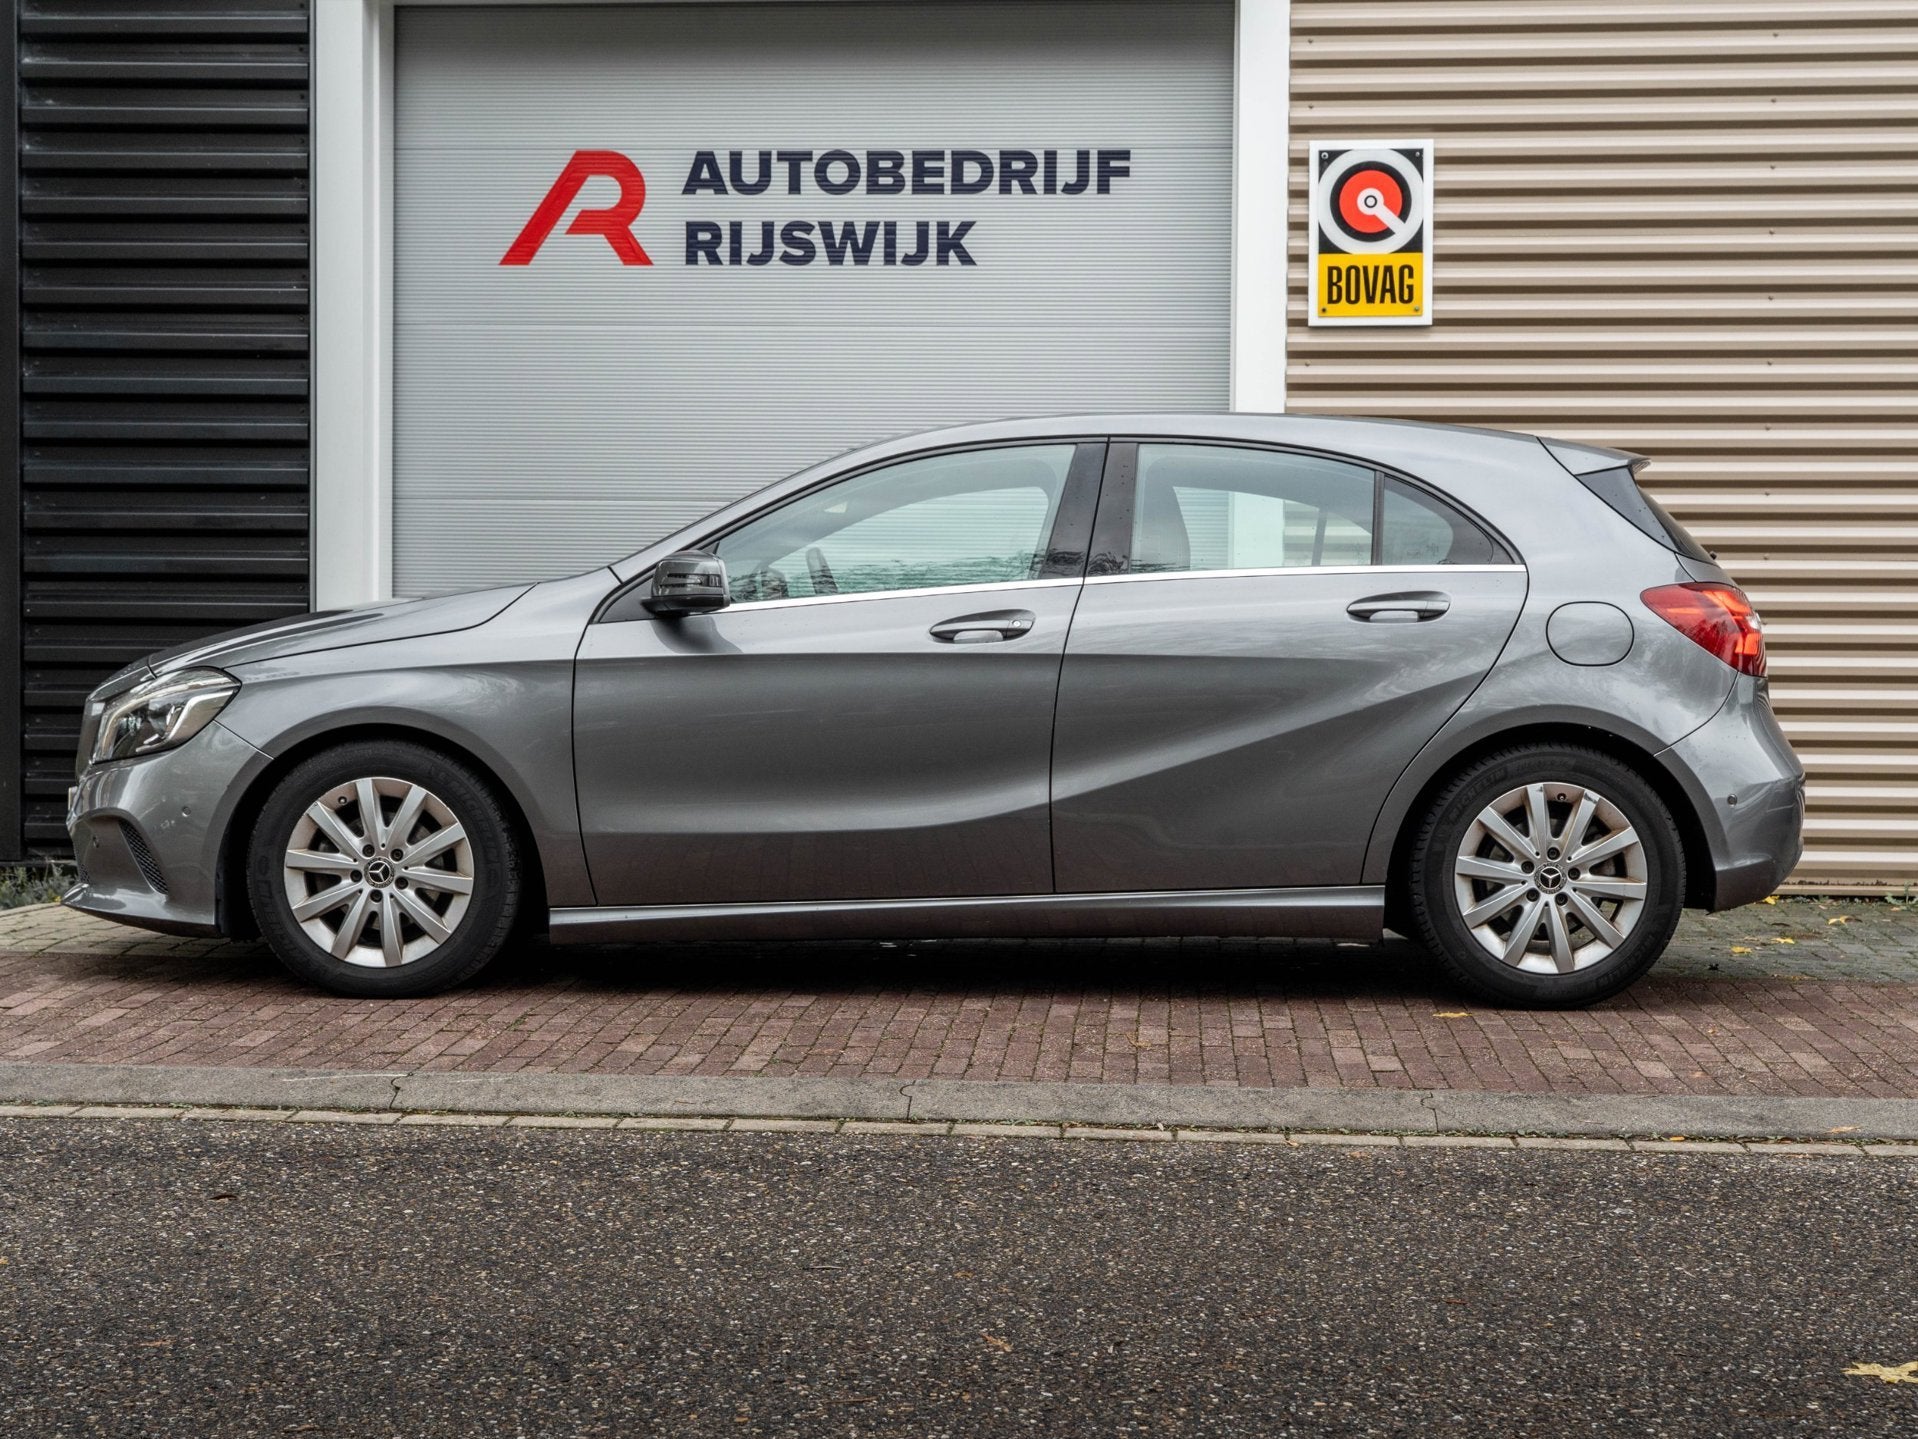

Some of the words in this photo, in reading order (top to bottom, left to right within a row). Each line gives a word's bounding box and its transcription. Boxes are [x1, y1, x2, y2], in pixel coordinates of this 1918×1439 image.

[682, 149, 1131, 195] AUTOBEDRIJF
[685, 220, 978, 266] RIJSWIJK
[1327, 264, 1414, 305] BOVAG
